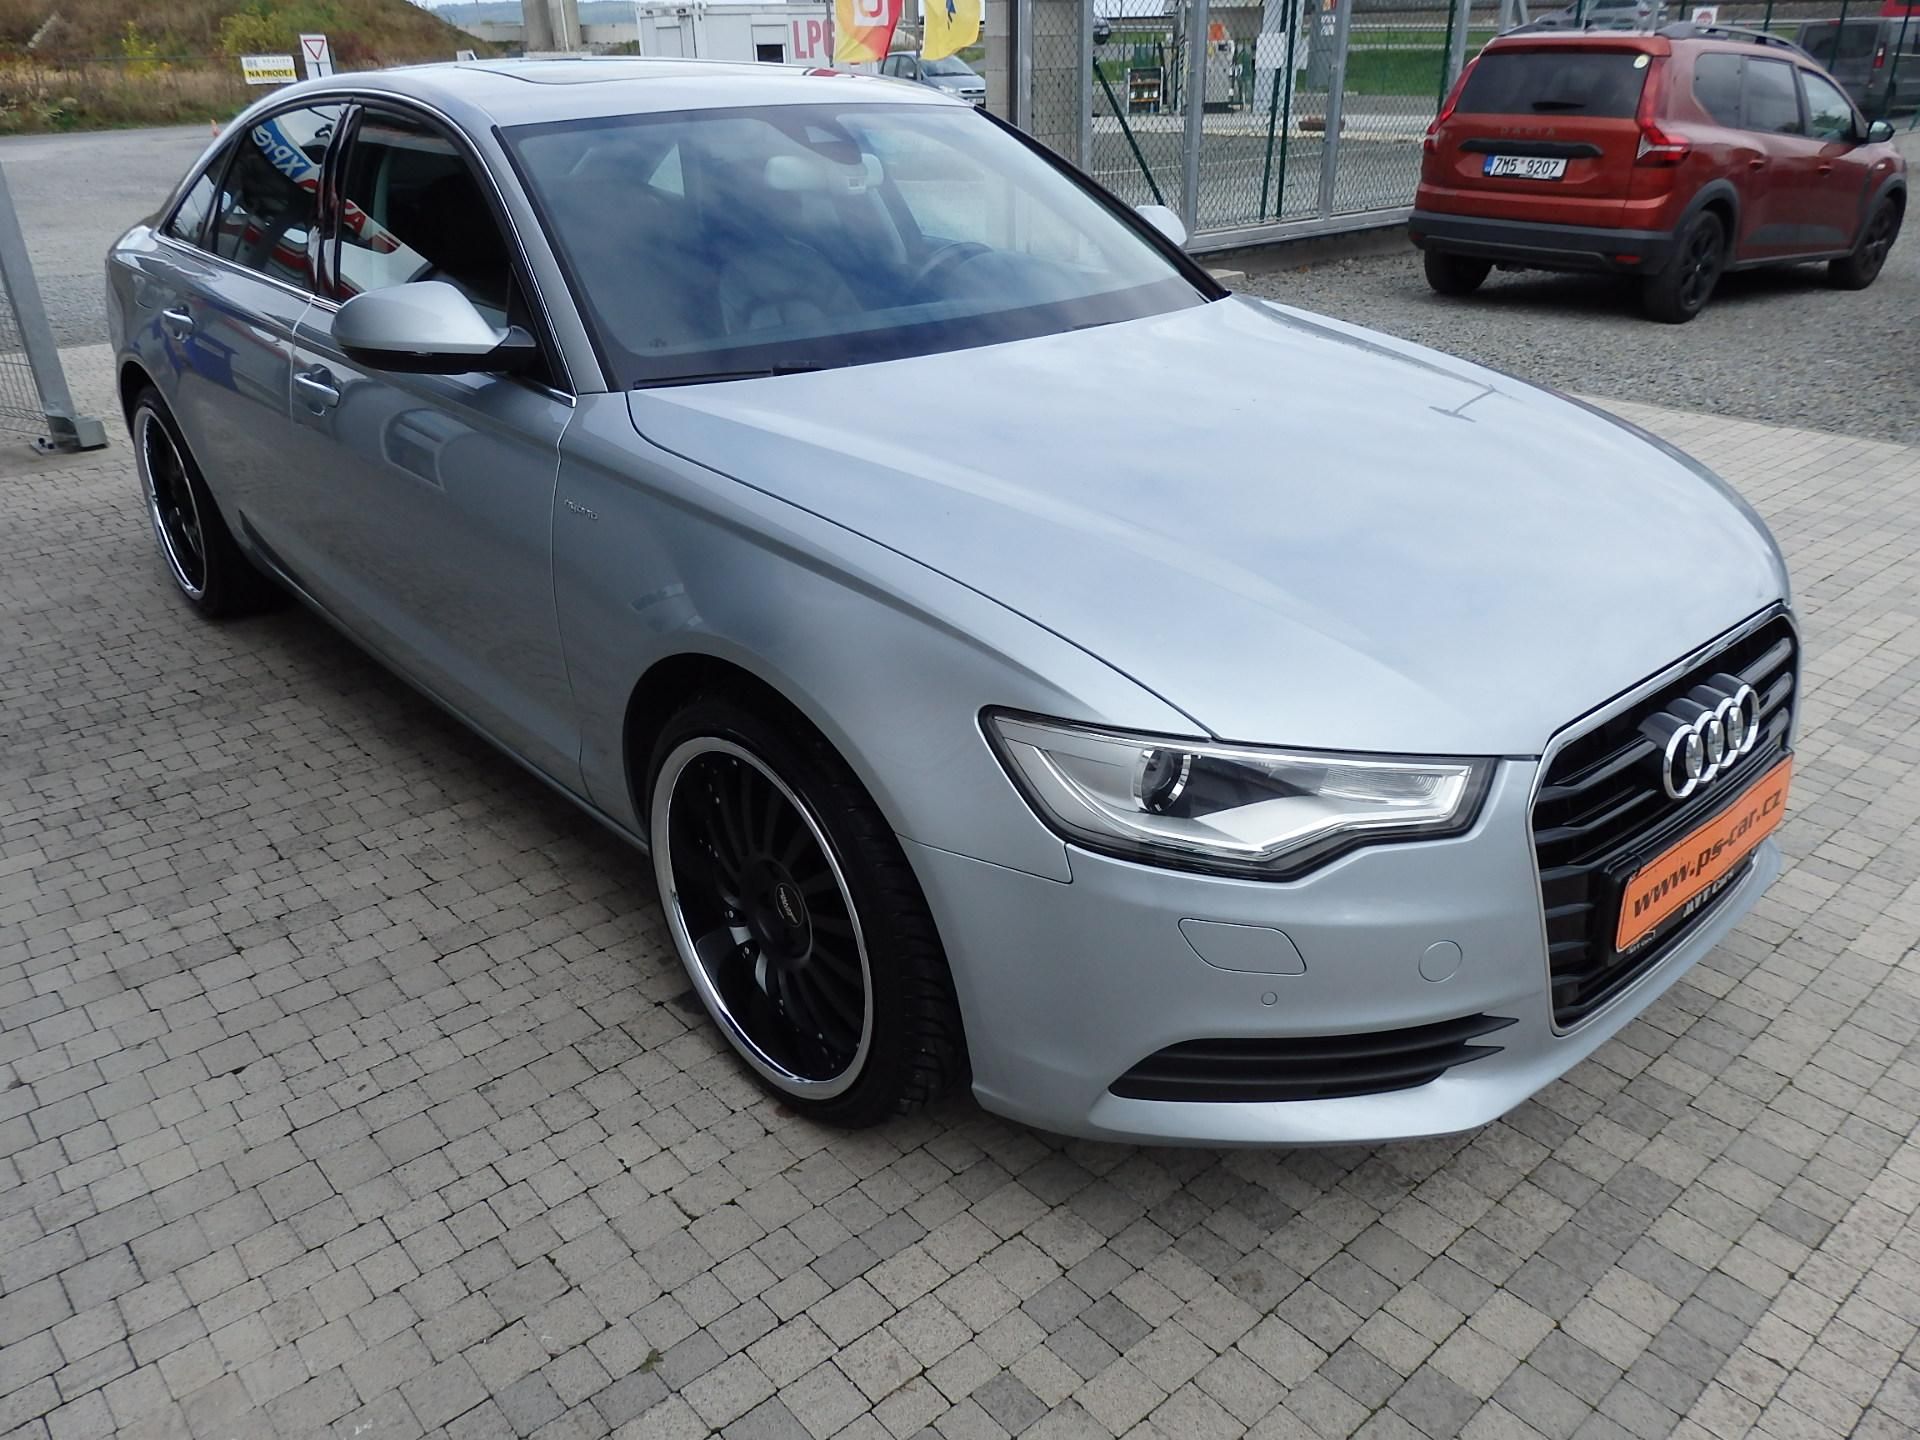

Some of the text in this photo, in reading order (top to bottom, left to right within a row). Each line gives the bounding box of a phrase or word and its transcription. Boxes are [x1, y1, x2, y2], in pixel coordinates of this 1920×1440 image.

[1494, 157, 1560, 175] 7M5 9207
[1633, 788, 1782, 918] www.ps-car.cz
